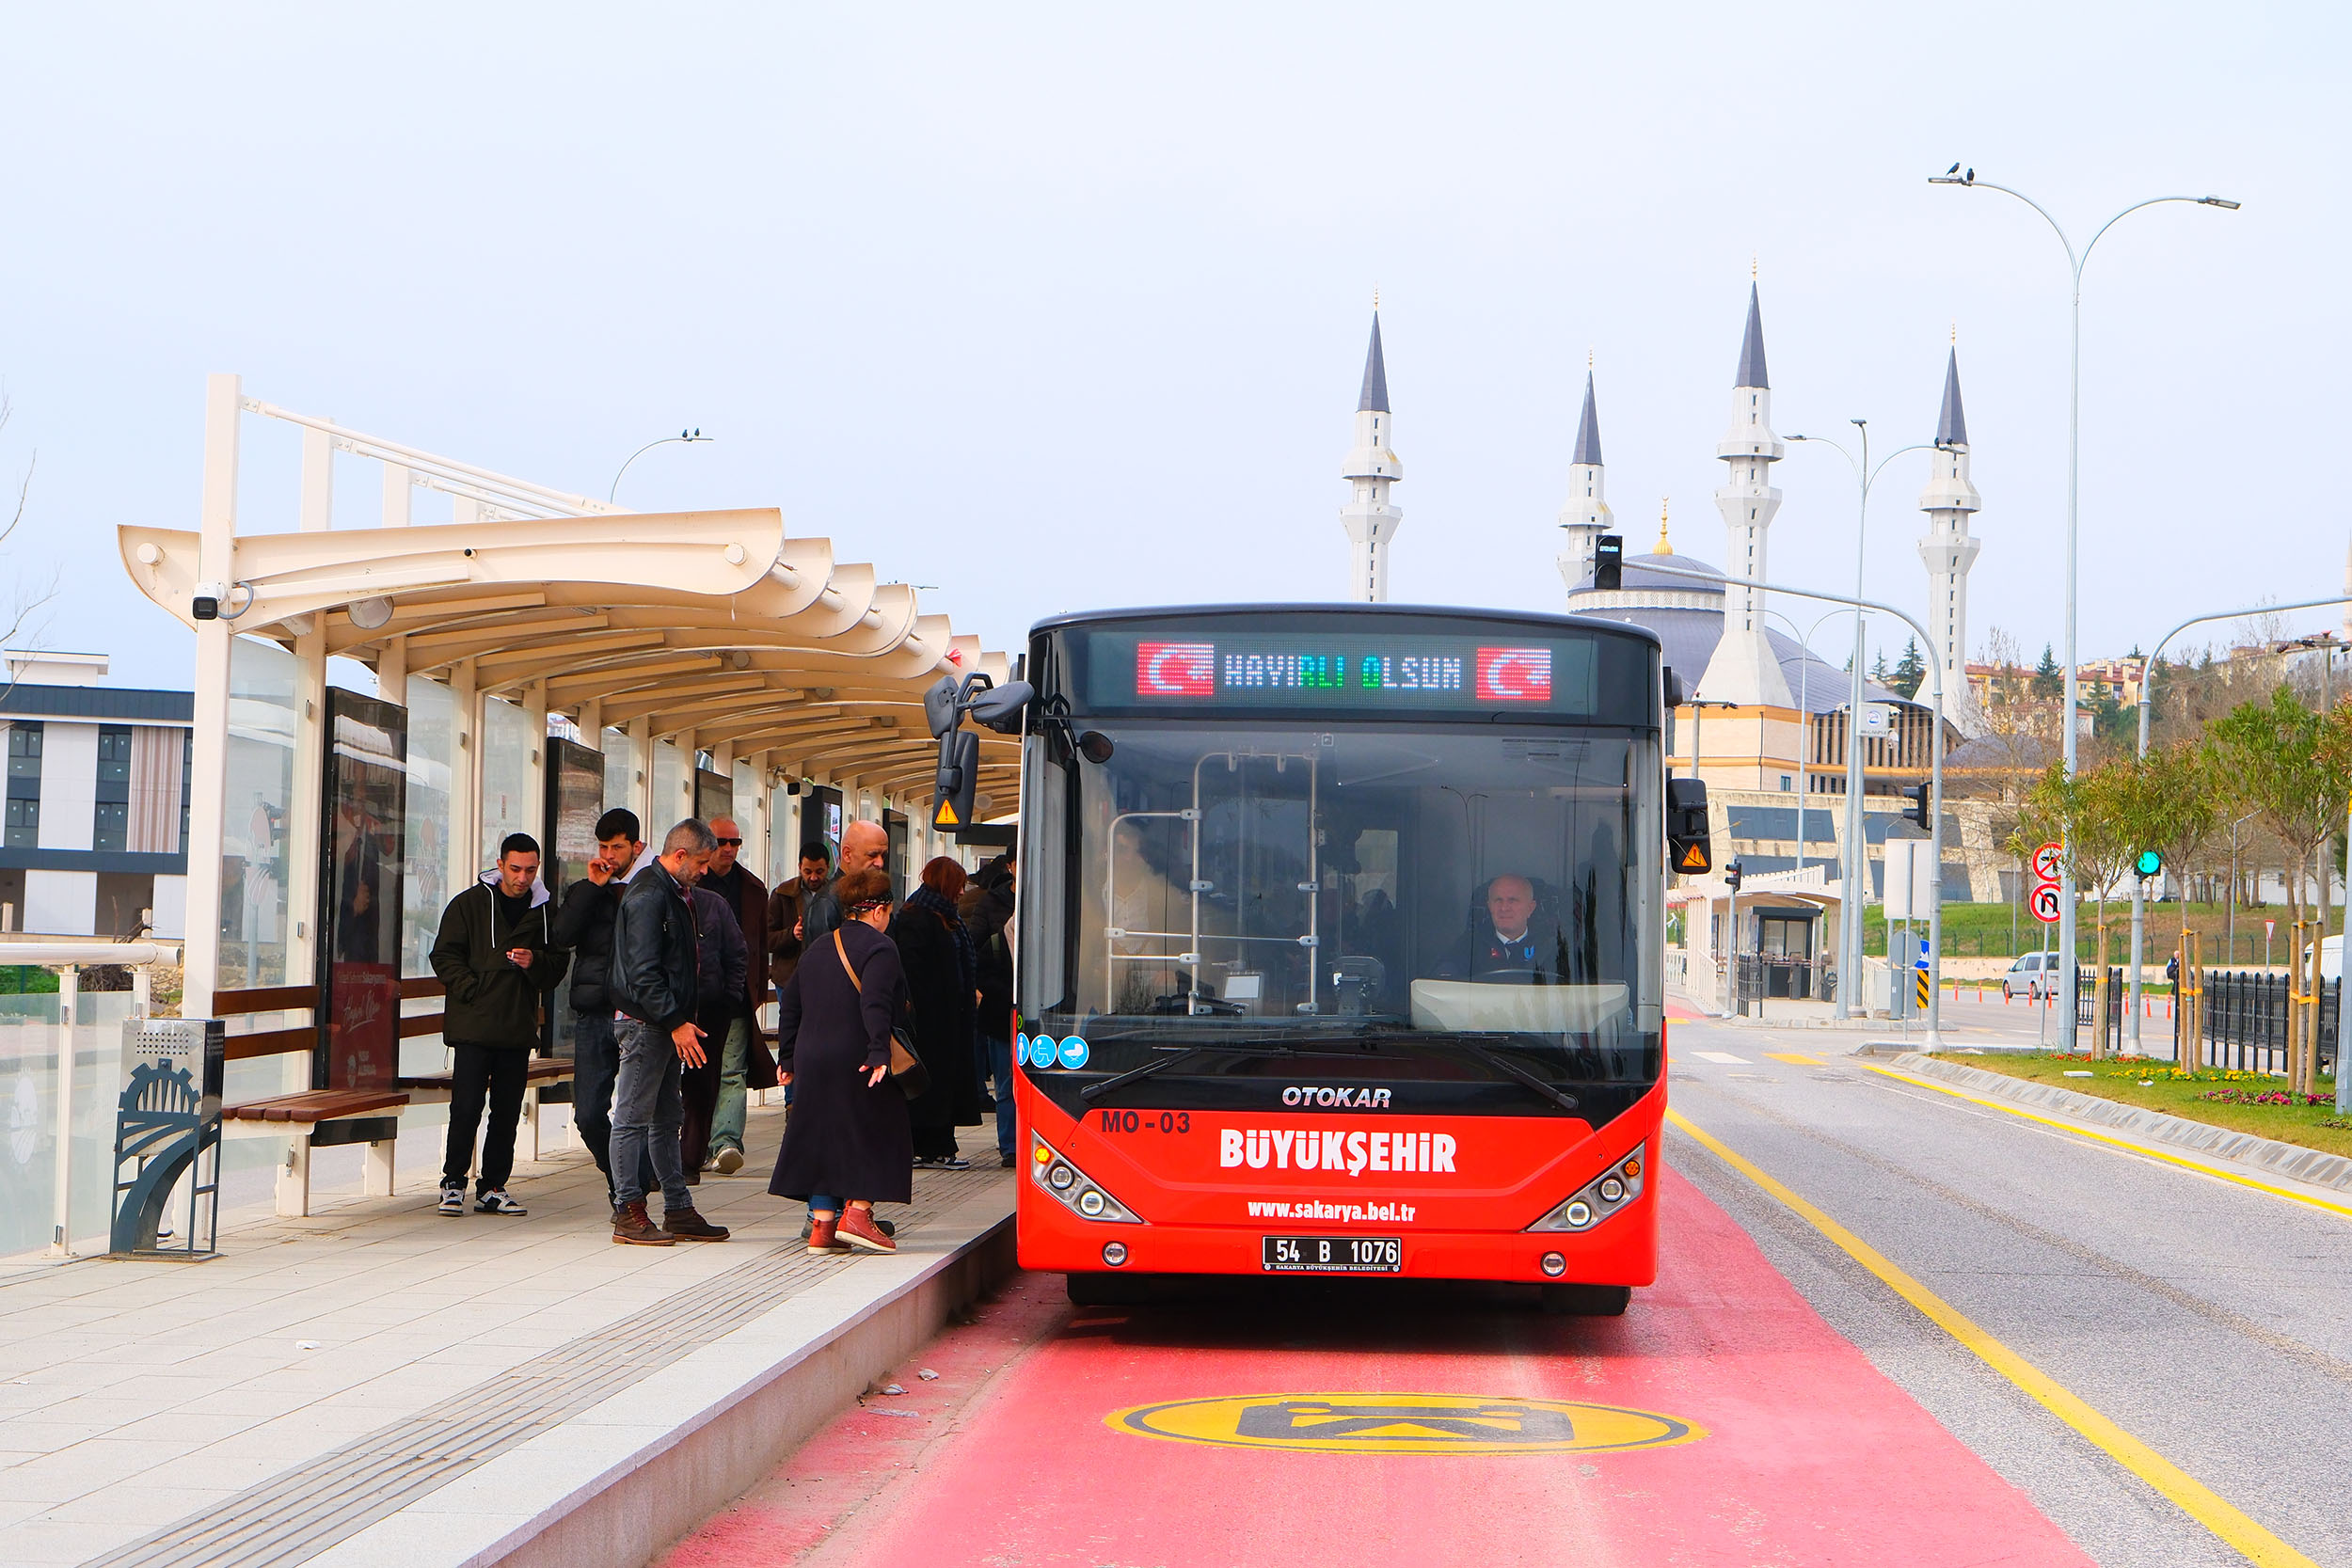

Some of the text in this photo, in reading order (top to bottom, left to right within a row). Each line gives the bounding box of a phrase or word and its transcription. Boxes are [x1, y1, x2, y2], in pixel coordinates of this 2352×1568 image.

[1225, 654, 1461, 689] HAYIRLI OLSUN
[1281, 1086, 1392, 1108] OTOKAR
[1220, 1129, 1457, 1178] BÜYÜKŞEHİR
[1248, 1200, 1416, 1223] www.sakarya.bel.tr
[1277, 1240, 1397, 1263] 54 B 1076
